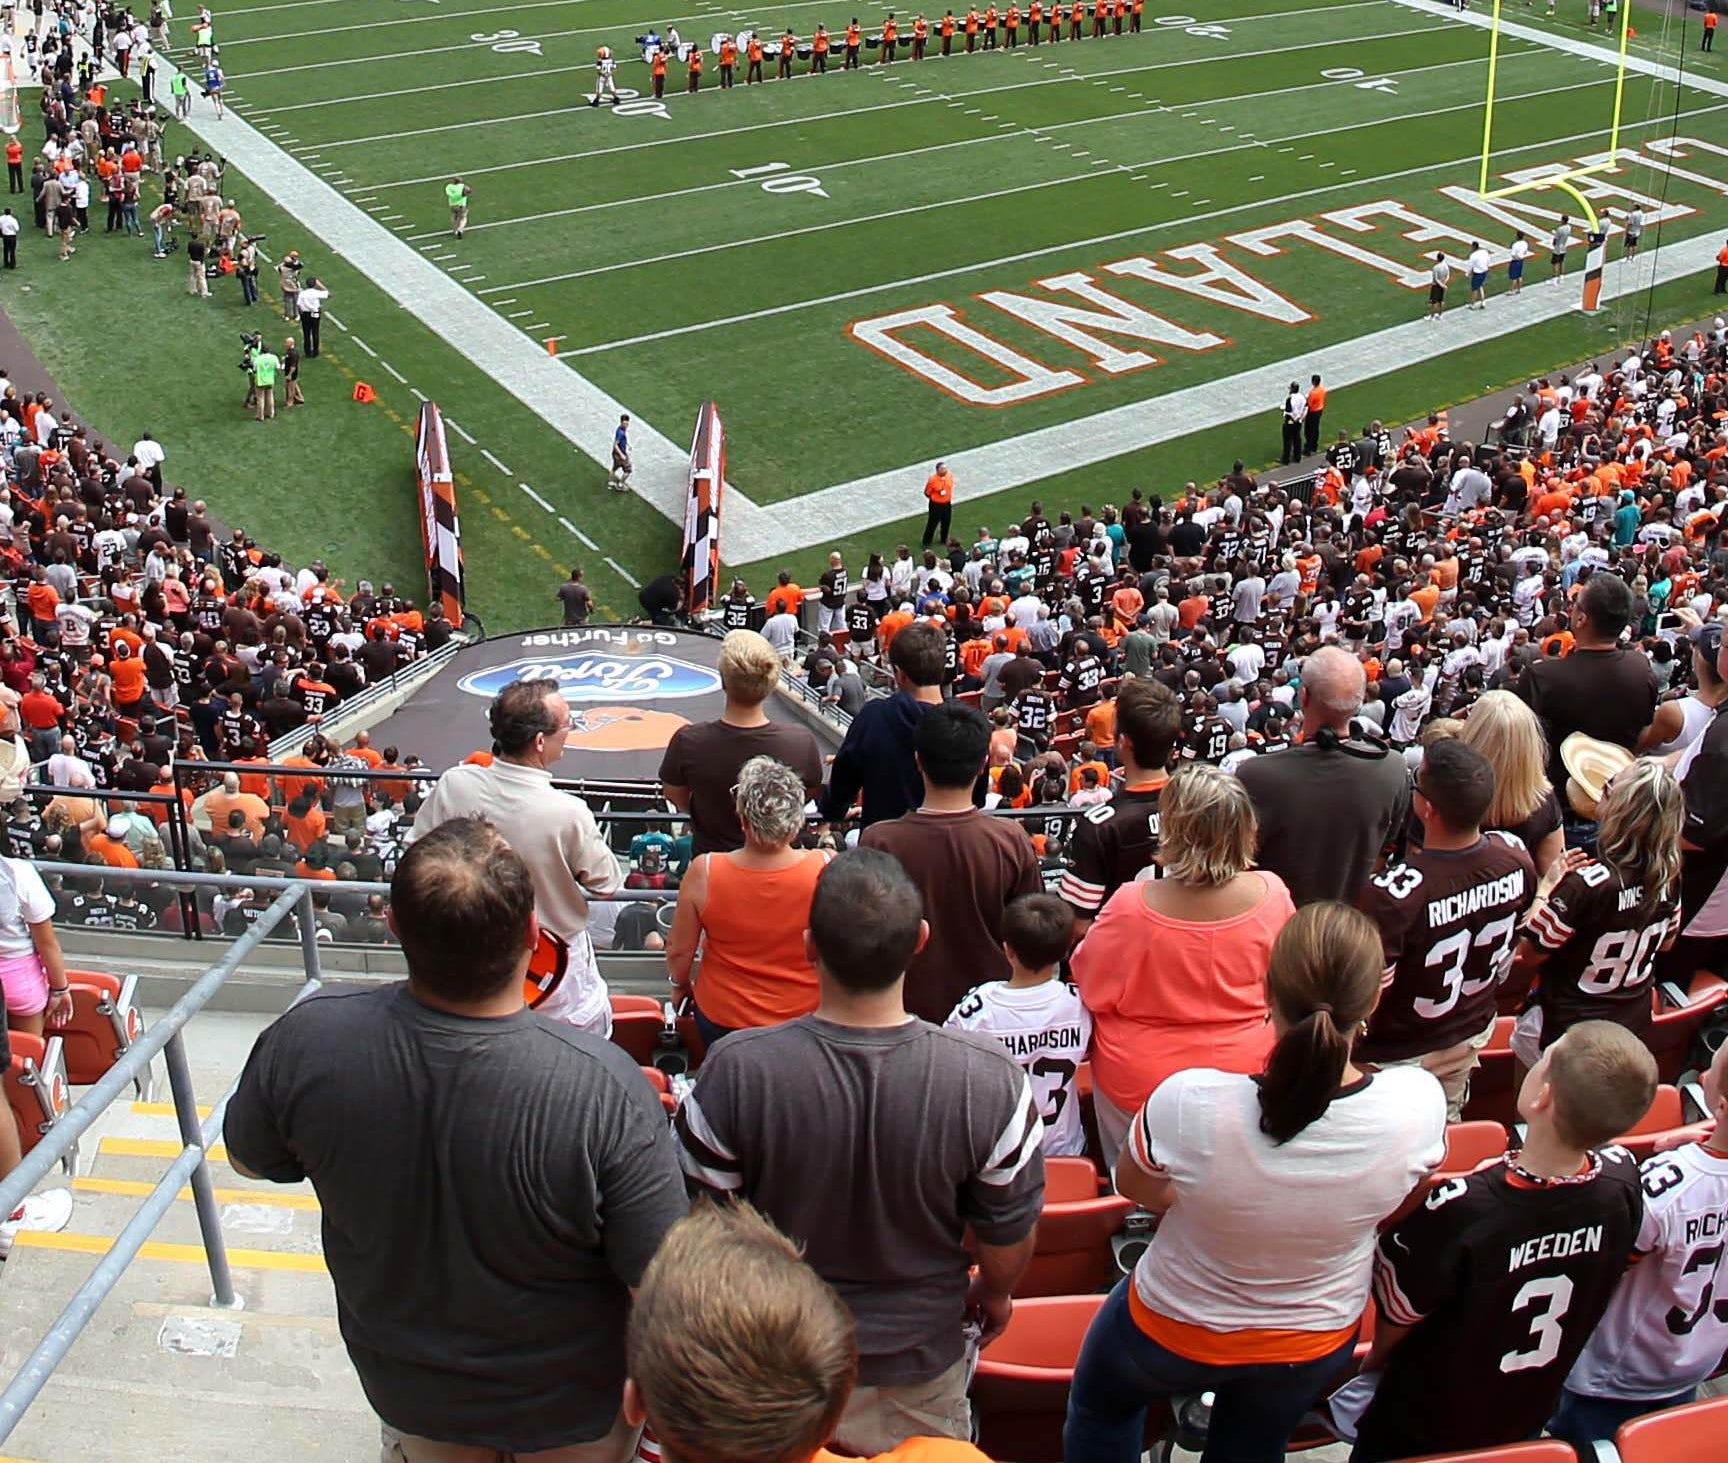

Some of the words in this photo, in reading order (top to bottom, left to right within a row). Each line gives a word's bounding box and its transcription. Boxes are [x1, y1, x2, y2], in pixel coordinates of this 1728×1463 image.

[1153, 15, 1232, 40] 20
[470, 29, 544, 56] 30
[1320, 67, 1399, 95] 10
[581, 88, 672, 120] 20
[728, 162, 830, 198] 10
[356, 383, 370, 401] G
[1336, 454, 1352, 469] 23
[1221, 540, 1239, 557] 32
[728, 612, 747, 626] 35
[852, 616, 869, 630] 33
[521, 629, 632, 647] Further
[646, 631, 678, 646] Go
[516, 659, 674, 691] Ford
[304, 697, 325, 714] 33
[1019, 706, 1047, 729] 32
[229, 728, 240, 747] 3
[1207, 735, 1227, 758] 19
[1373, 860, 1424, 901] 33
[1428, 868, 1526, 929] RICHARDSON
[1412, 917, 1517, 1019] 33
[1577, 926, 1659, 994] 80
[1509, 1225, 1603, 1273] WEEDEN
[1498, 1274, 1575, 1373] 3
